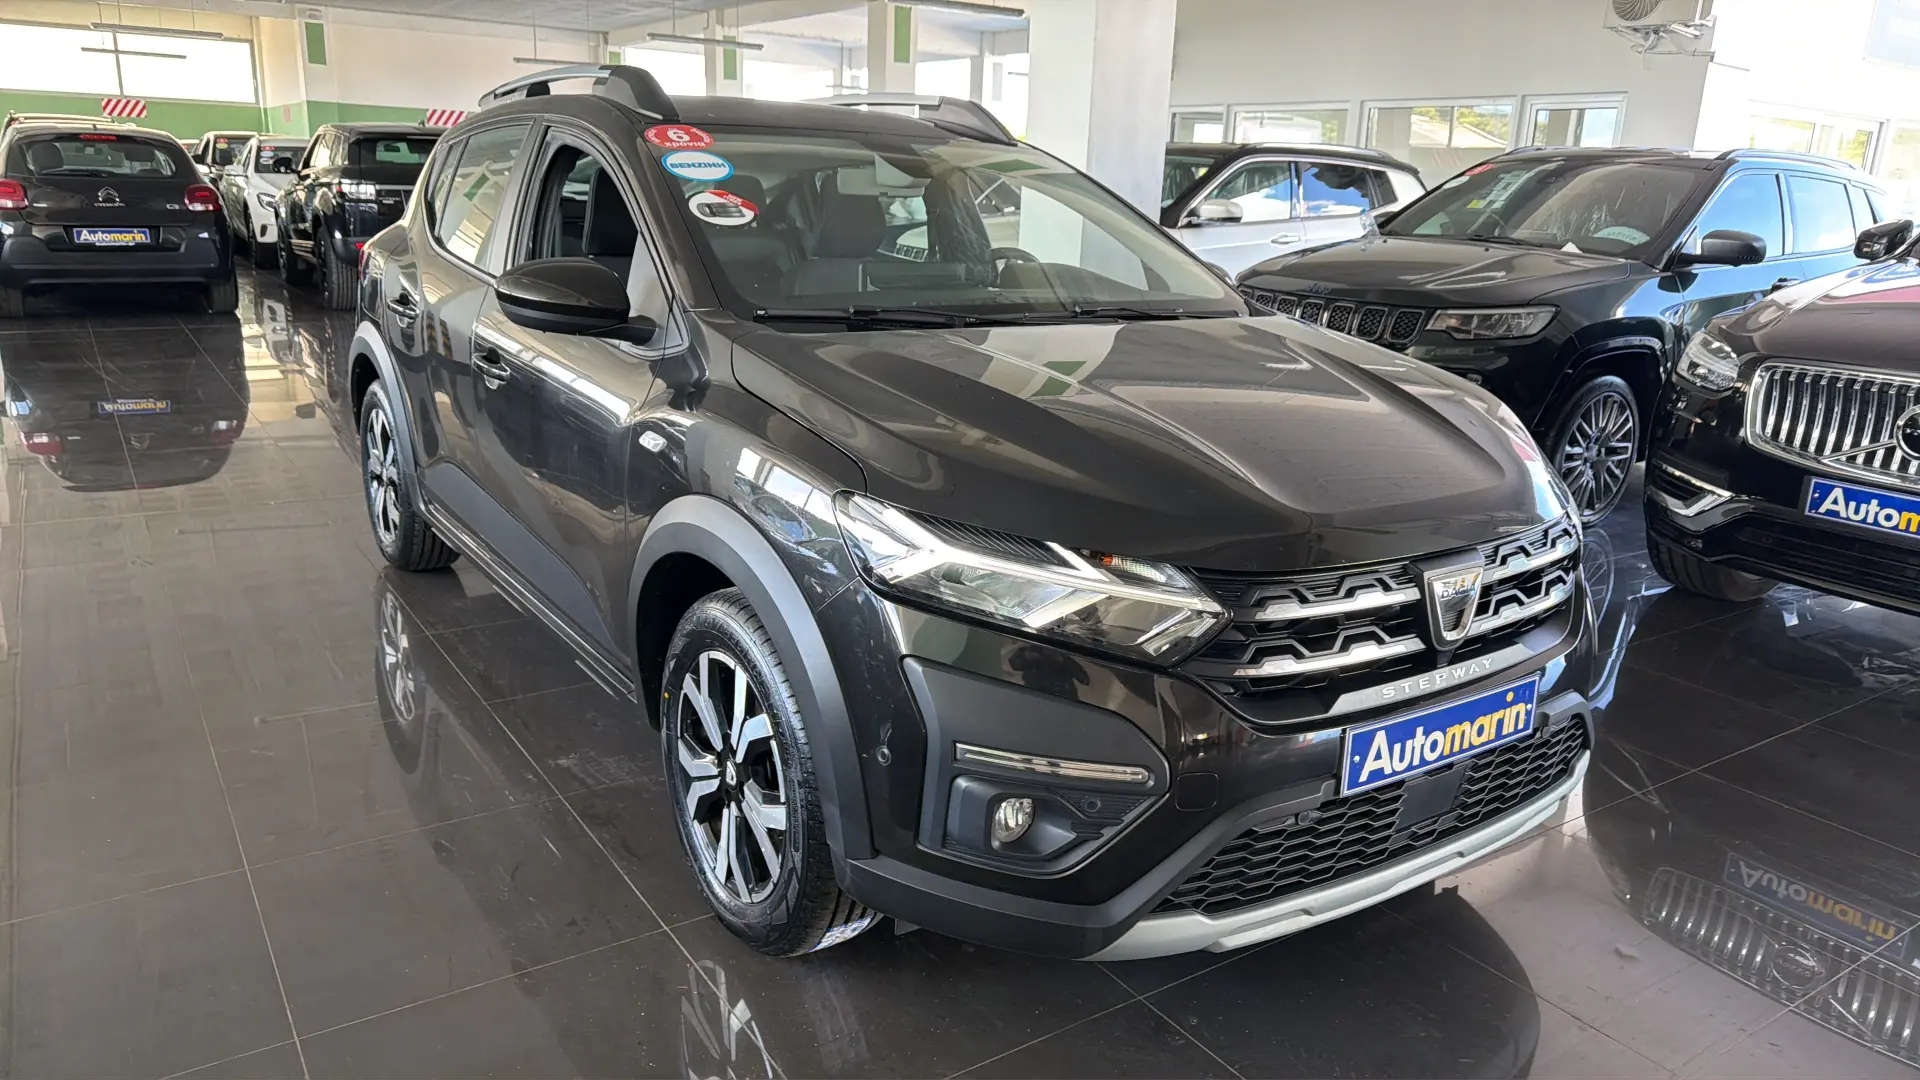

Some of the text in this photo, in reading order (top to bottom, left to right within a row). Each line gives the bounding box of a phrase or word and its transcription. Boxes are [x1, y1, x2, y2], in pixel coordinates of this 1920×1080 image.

[666, 129, 691, 142] 6
[80, 229, 146, 241] Automarin
[1382, 657, 1494, 699] STEPWAY
[1358, 691, 1527, 783] Automarin
